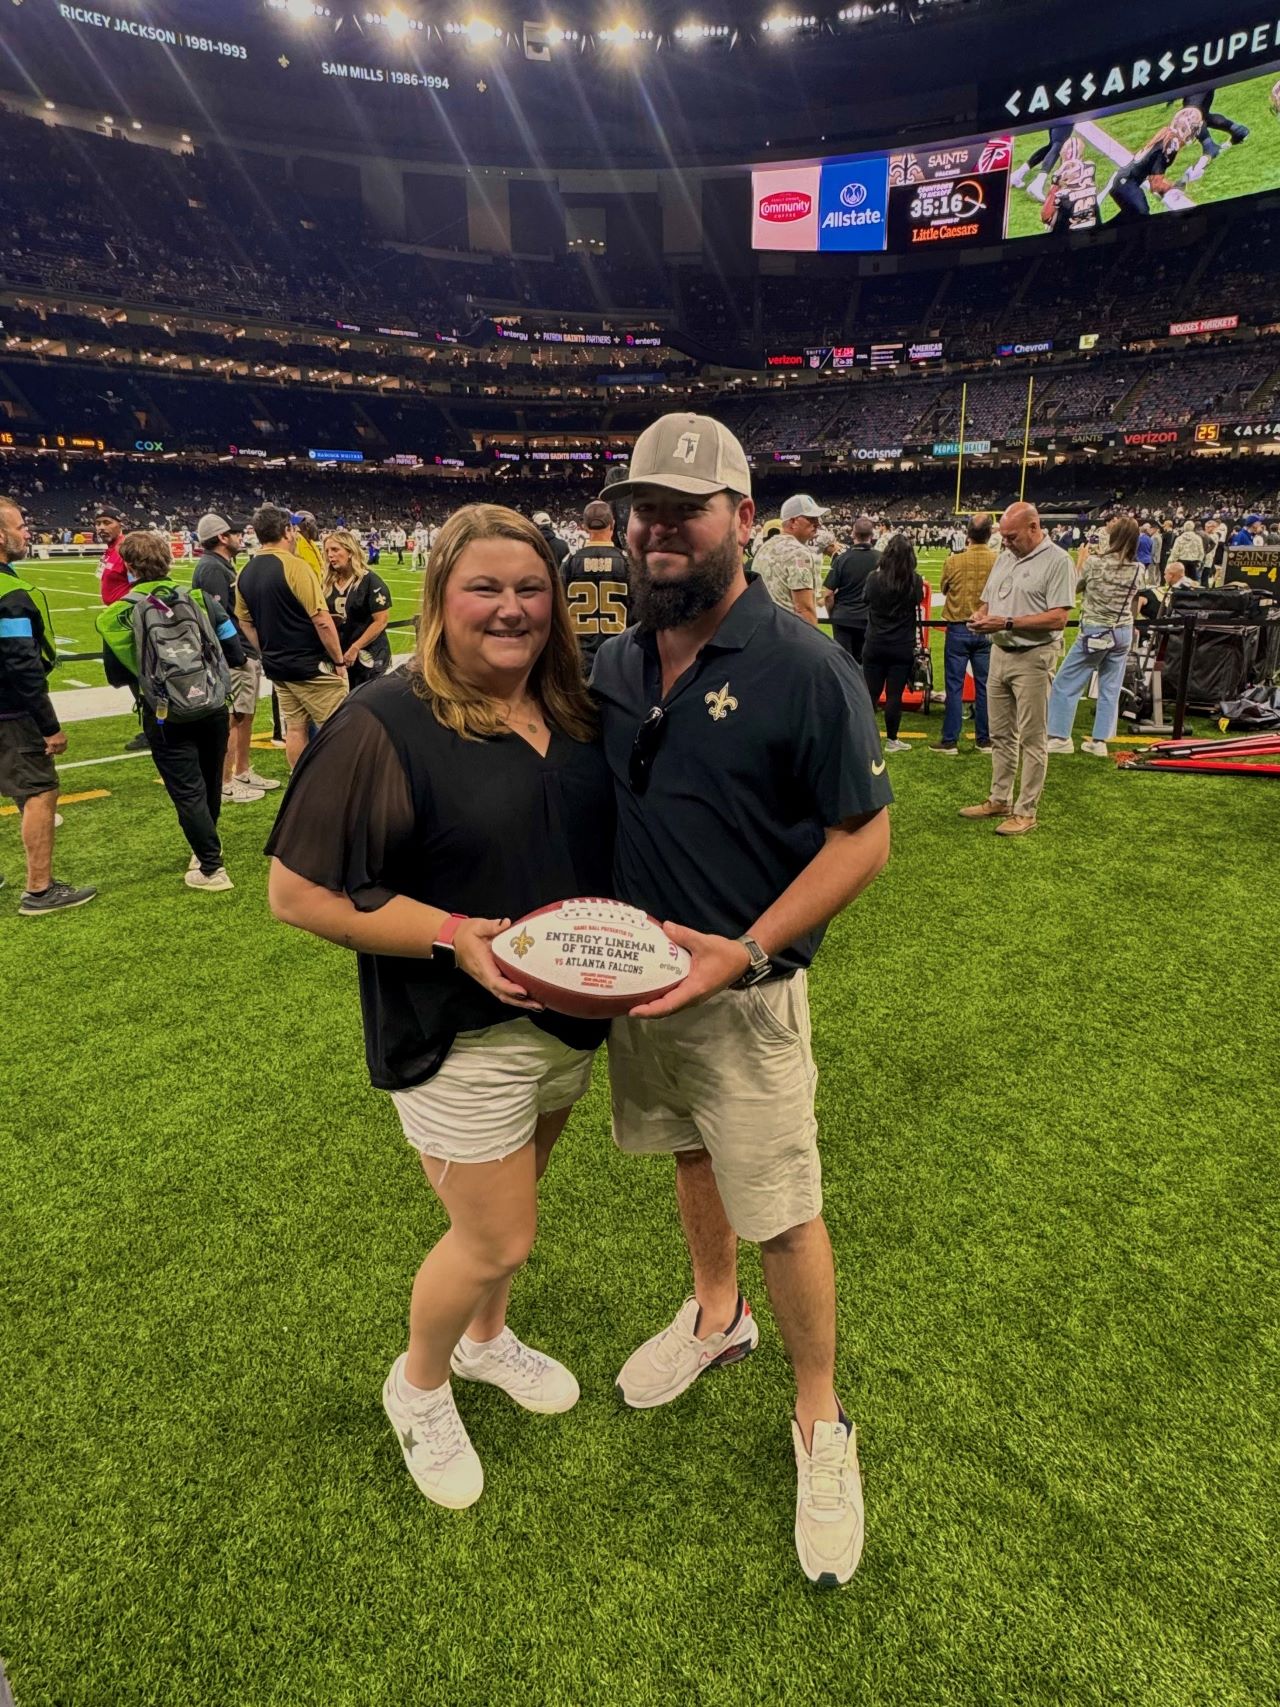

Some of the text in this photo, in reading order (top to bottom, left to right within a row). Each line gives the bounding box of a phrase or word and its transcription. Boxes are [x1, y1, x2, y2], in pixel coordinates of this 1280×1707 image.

[60, 4, 248, 59] RICKEY JACKSON 1981-1993
[322, 62, 450, 89] SAM MILLS 1986-1994
[1004, 51, 1175, 117] CAESARS
[928, 150, 969, 168] SAINTS
[761, 200, 811, 216] Community
[910, 193, 963, 218] 35:16
[821, 208, 881, 229] Allstate
[912, 223, 979, 242] Little Caesars
[1170, 316, 1238, 335] ROUSES MARKETS
[503, 330, 528, 341] entergy
[543, 332, 611, 345] PATRON SAINTS PARTNERS
[635, 337, 661, 346] entergy
[1014, 342, 1049, 353] Chevron
[768, 355, 802, 365] verizon
[1072, 434, 1103, 444] SAINTS
[1123, 431, 1177, 445] verizon
[1197, 426, 1217, 439] 25
[135, 440, 163, 451] COX
[238, 447, 267, 457] entergy
[857, 448, 902, 460] Ochsner
[1235, 552, 1279, 561] SAINTS
[583, 557, 613, 572] BUSH
[1267, 567, 1278, 583] 4
[567, 581, 628, 635] 25
[545, 931, 656, 954] ENTERGY LINEMAN
[562, 943, 640, 962] OF THE GAME
[555, 957, 644, 976] VS ATLANTA FALCONS
[659, 961, 683, 975] entergy
